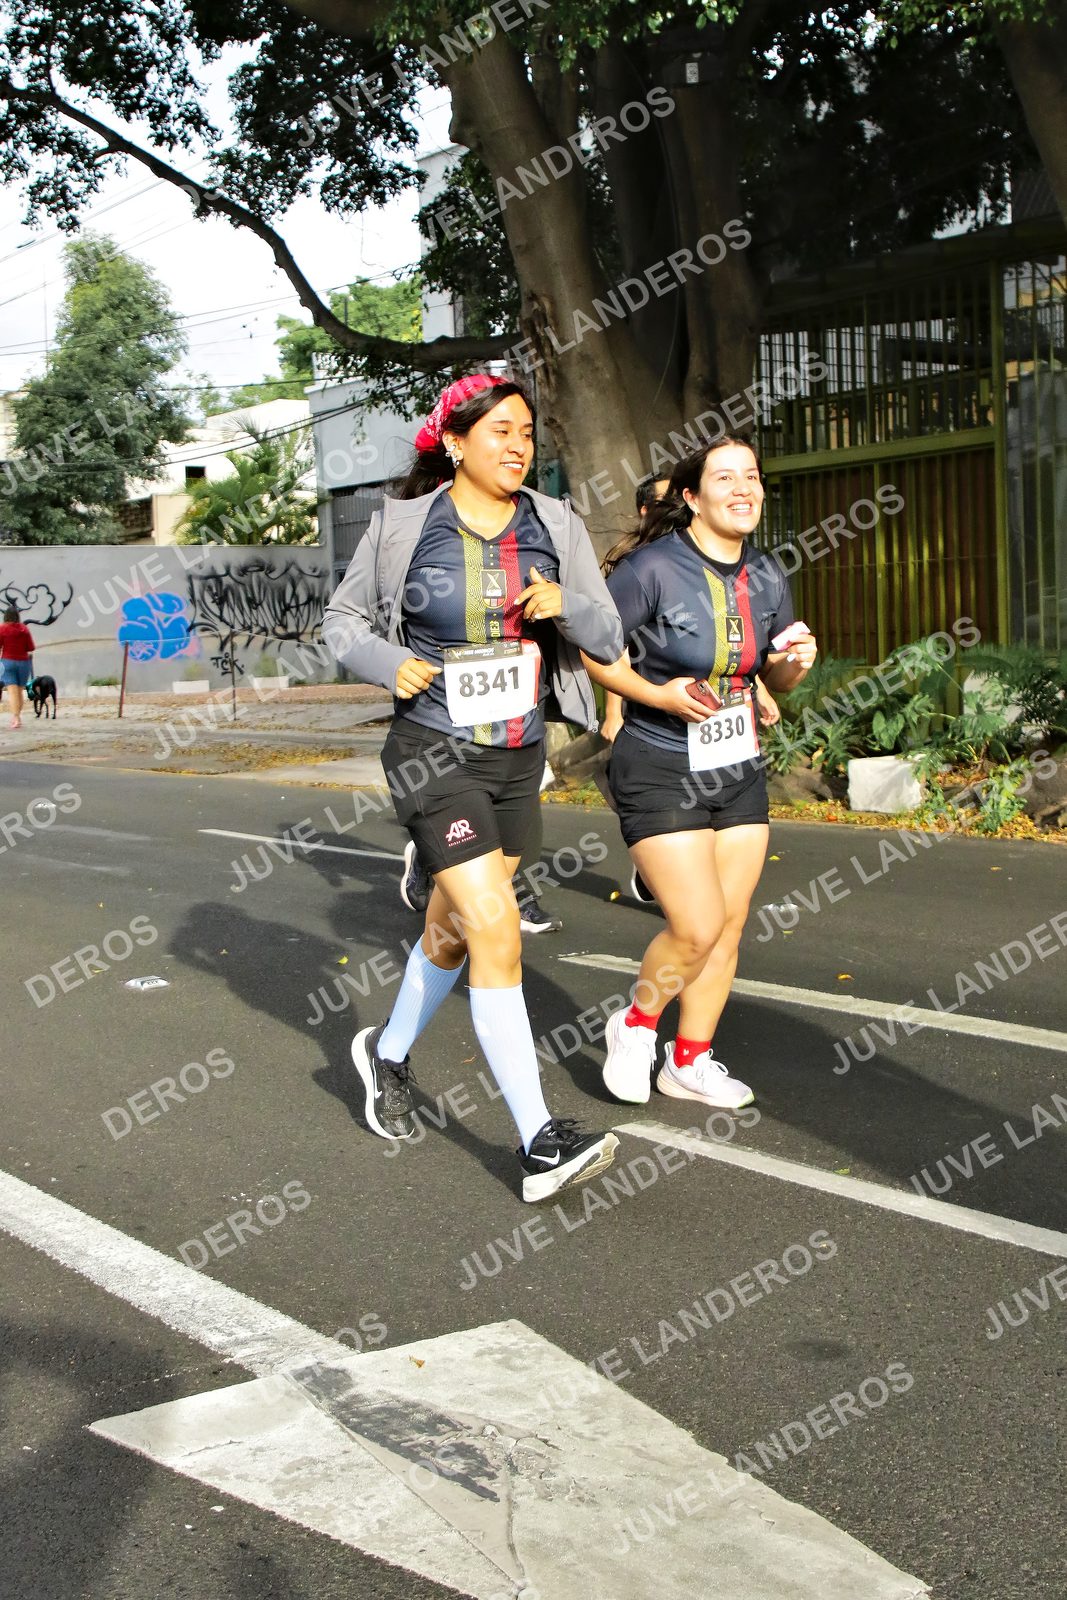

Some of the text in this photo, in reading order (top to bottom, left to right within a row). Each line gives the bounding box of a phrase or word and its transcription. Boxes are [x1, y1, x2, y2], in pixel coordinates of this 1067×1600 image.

[458, 665, 520, 698] 8341
[699, 714, 745, 745] 8330
[445, 818, 474, 842] AR
